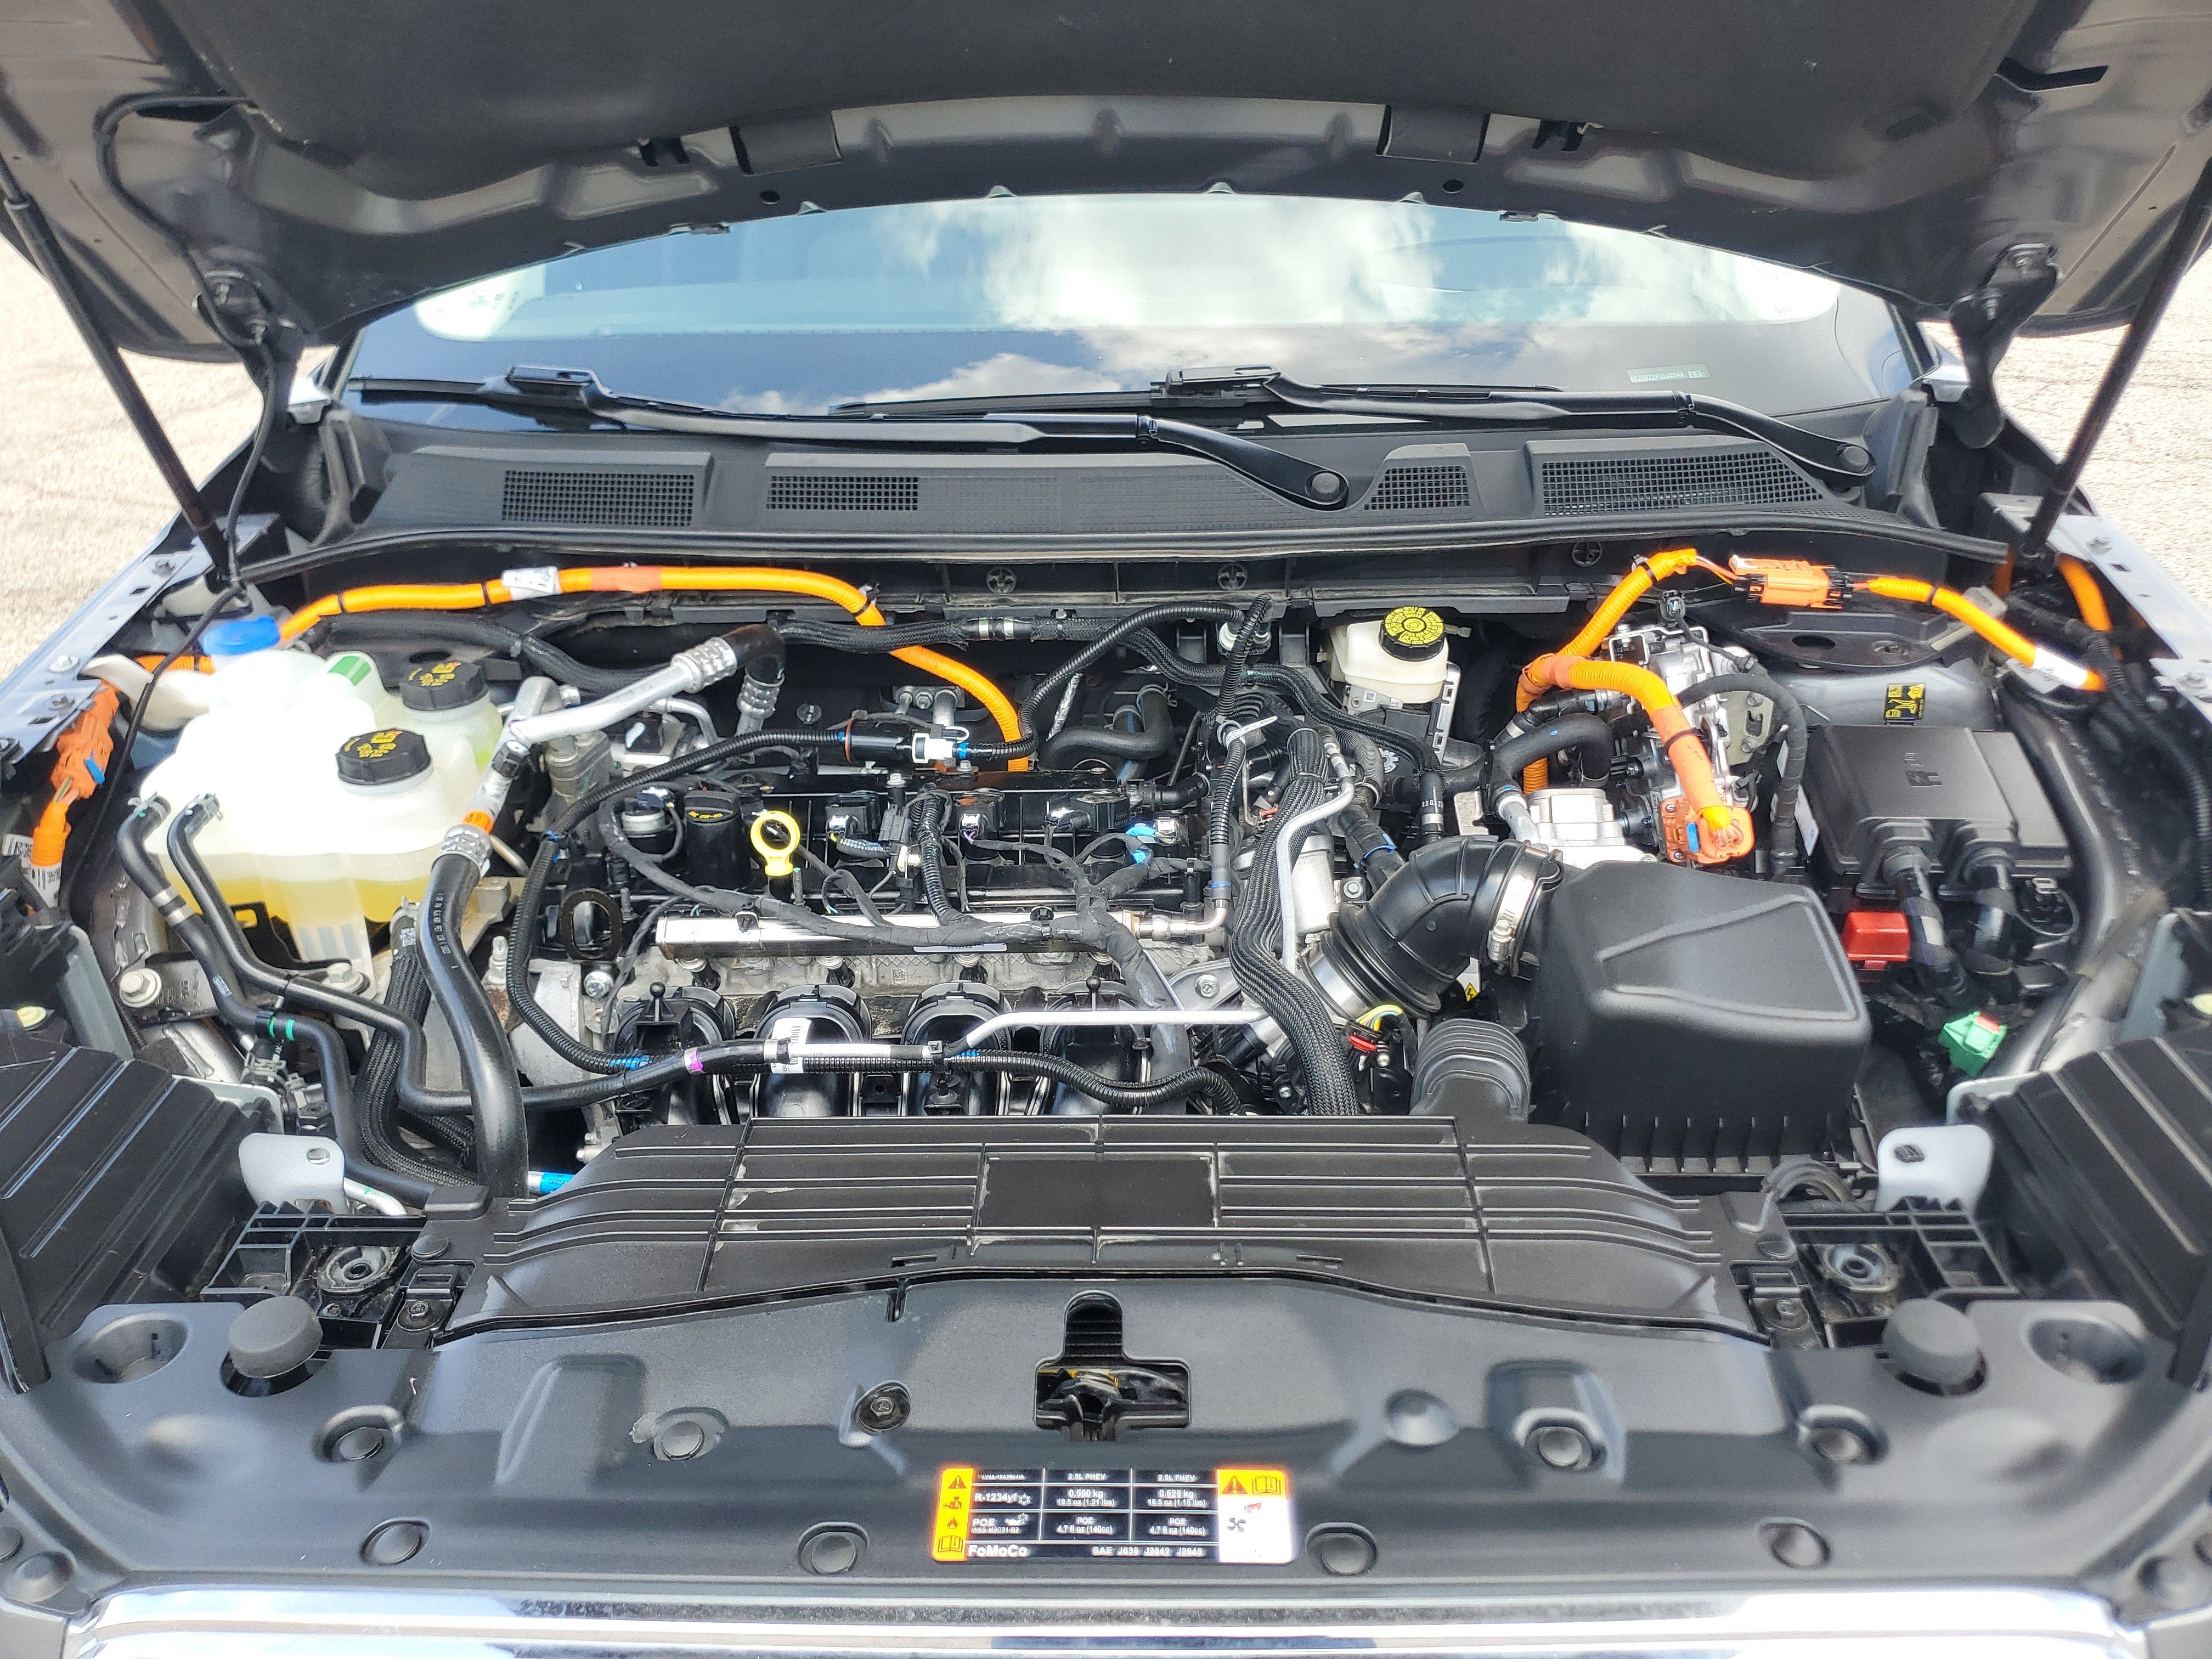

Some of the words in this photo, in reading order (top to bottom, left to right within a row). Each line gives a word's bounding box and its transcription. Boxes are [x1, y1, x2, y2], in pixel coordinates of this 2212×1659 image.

[974, 1493, 1017, 1504] R-1234yf
[1069, 1489, 1091, 1497] 0.550
[1093, 1489, 1104, 1499] kg
[1159, 1489, 1181, 1497] 0.525
[1183, 1489, 1194, 1499] kg
[1084, 1498, 1099, 1507] (1.21
[1102, 1498, 1115, 1507] lbs)
[1192, 1499, 1206, 1508] lbs)
[1179, 1526, 1205, 1536] (140cc)
[968, 1544, 1028, 1557] FoMoCo
[1093, 1546, 1113, 1554] SAE
[1117, 1546, 1139, 1554] J639
[1144, 1547, 1170, 1555] J2842
[1176, 1547, 1203, 1555] J2845
